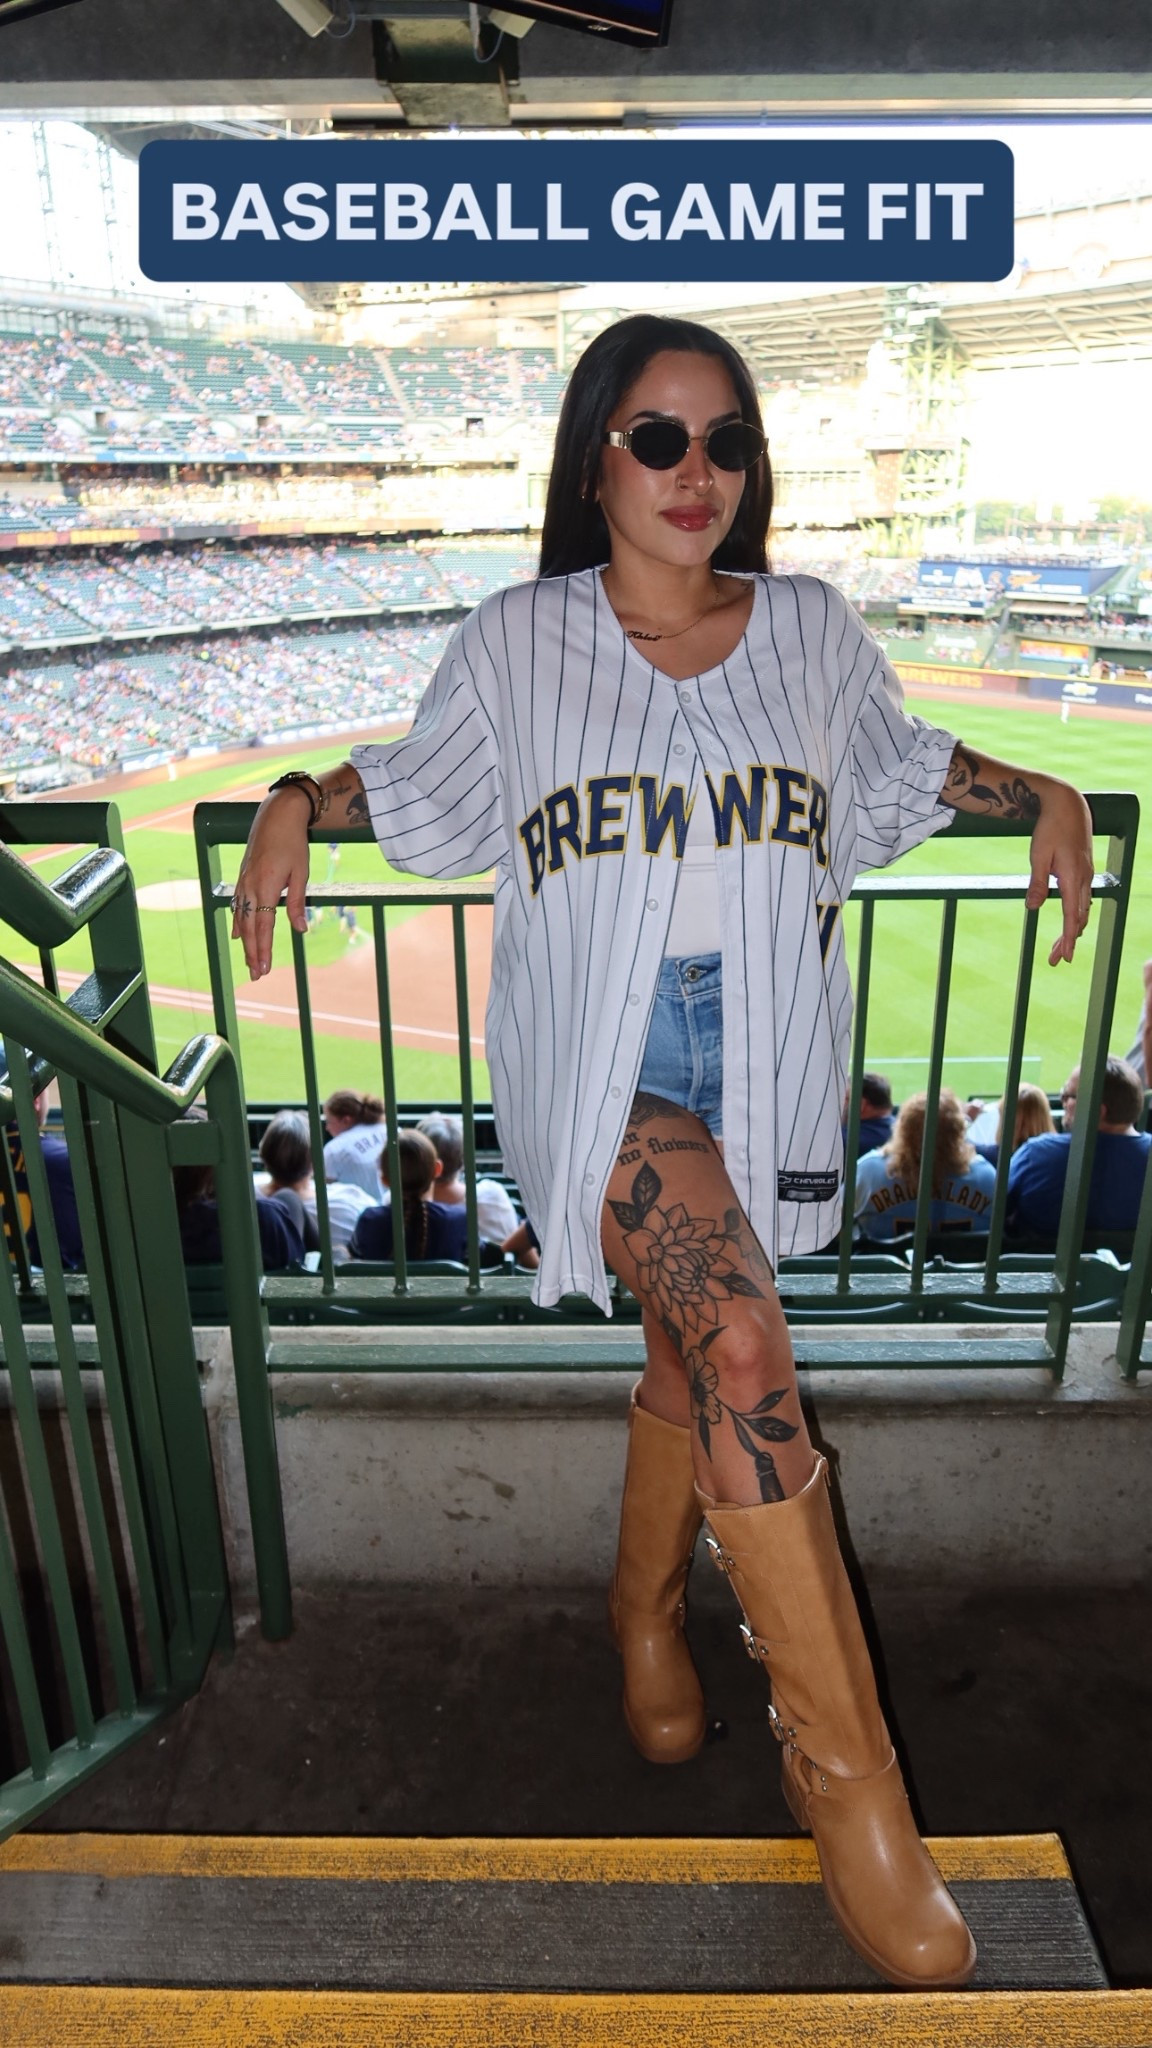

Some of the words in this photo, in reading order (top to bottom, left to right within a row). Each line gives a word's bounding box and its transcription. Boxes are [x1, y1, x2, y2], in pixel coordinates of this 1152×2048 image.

[897, 667, 984, 690] BREWERS
[354, 1133, 386, 1154] BRA
[647, 1137, 709, 1155] flowers
[793, 1177, 837, 1185] CHEVROLET
[945, 1182, 991, 1215] LADY
